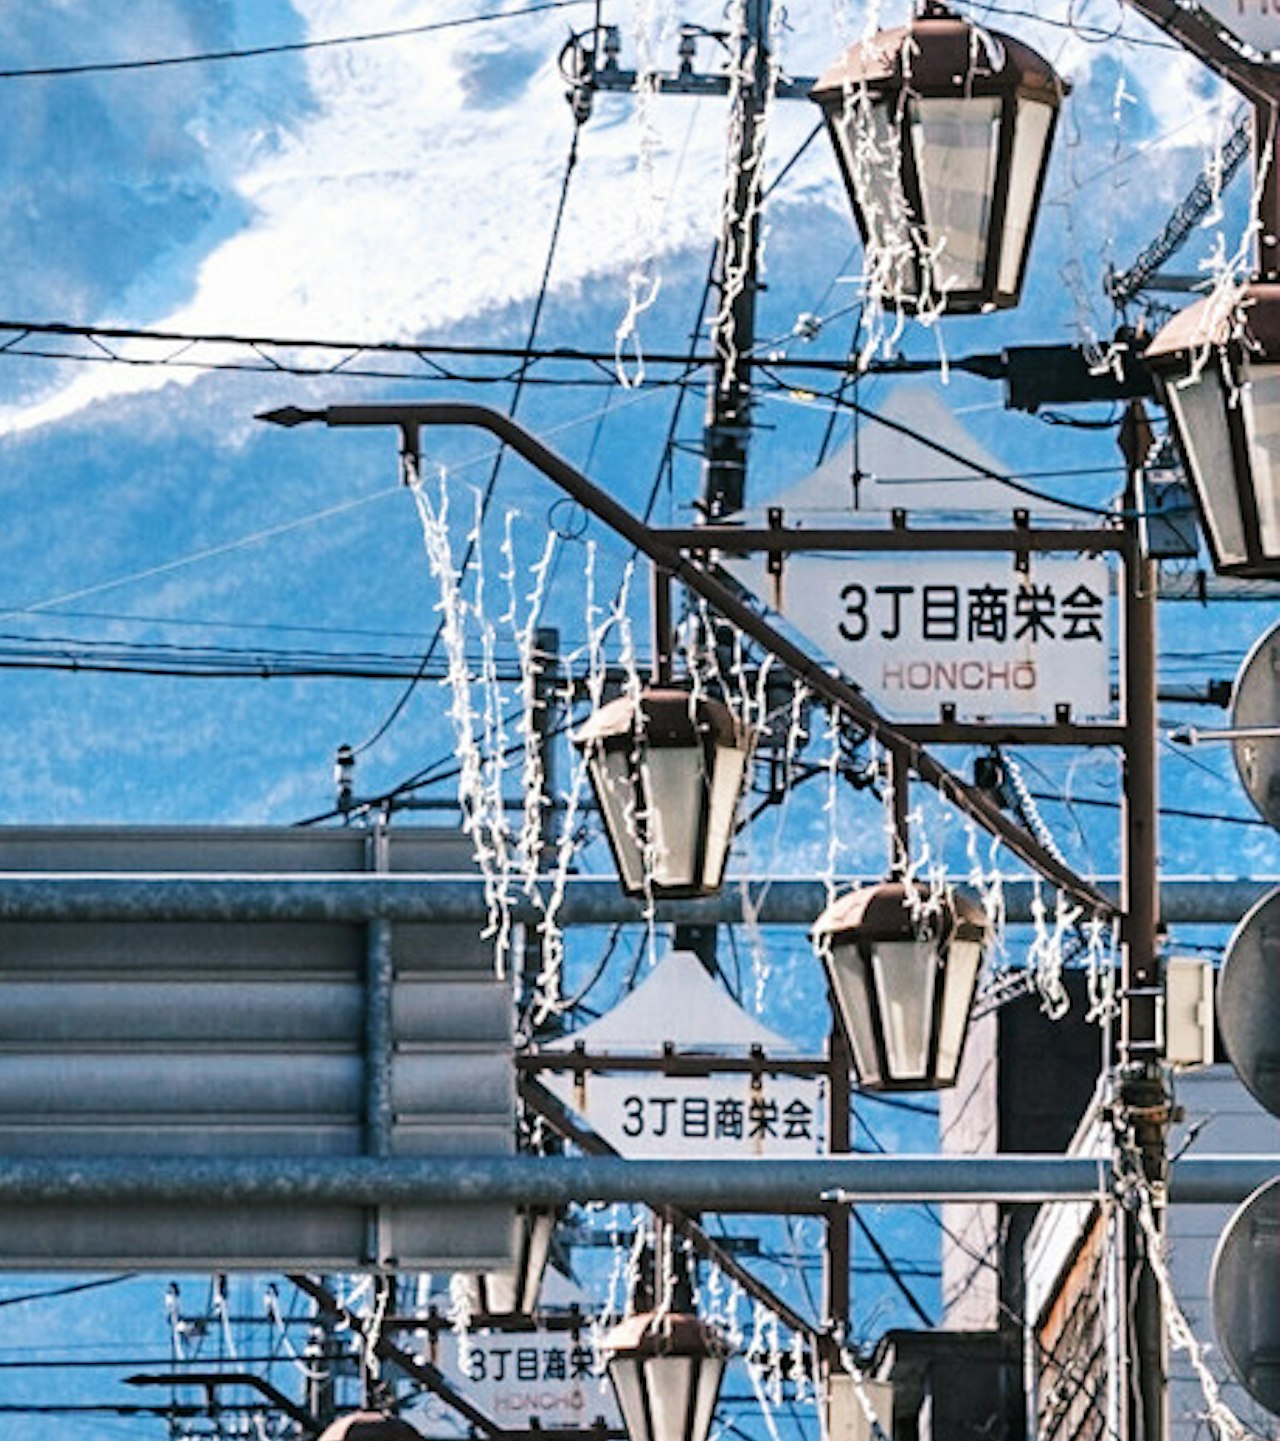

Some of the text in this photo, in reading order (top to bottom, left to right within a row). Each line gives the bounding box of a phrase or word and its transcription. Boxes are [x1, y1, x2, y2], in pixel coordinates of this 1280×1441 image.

[838, 582, 1104, 644] 3丁目商栄会
[622, 1095, 815, 1142] 3丁目商栄会
[469, 1347, 608, 1382] 3丁目商栄
